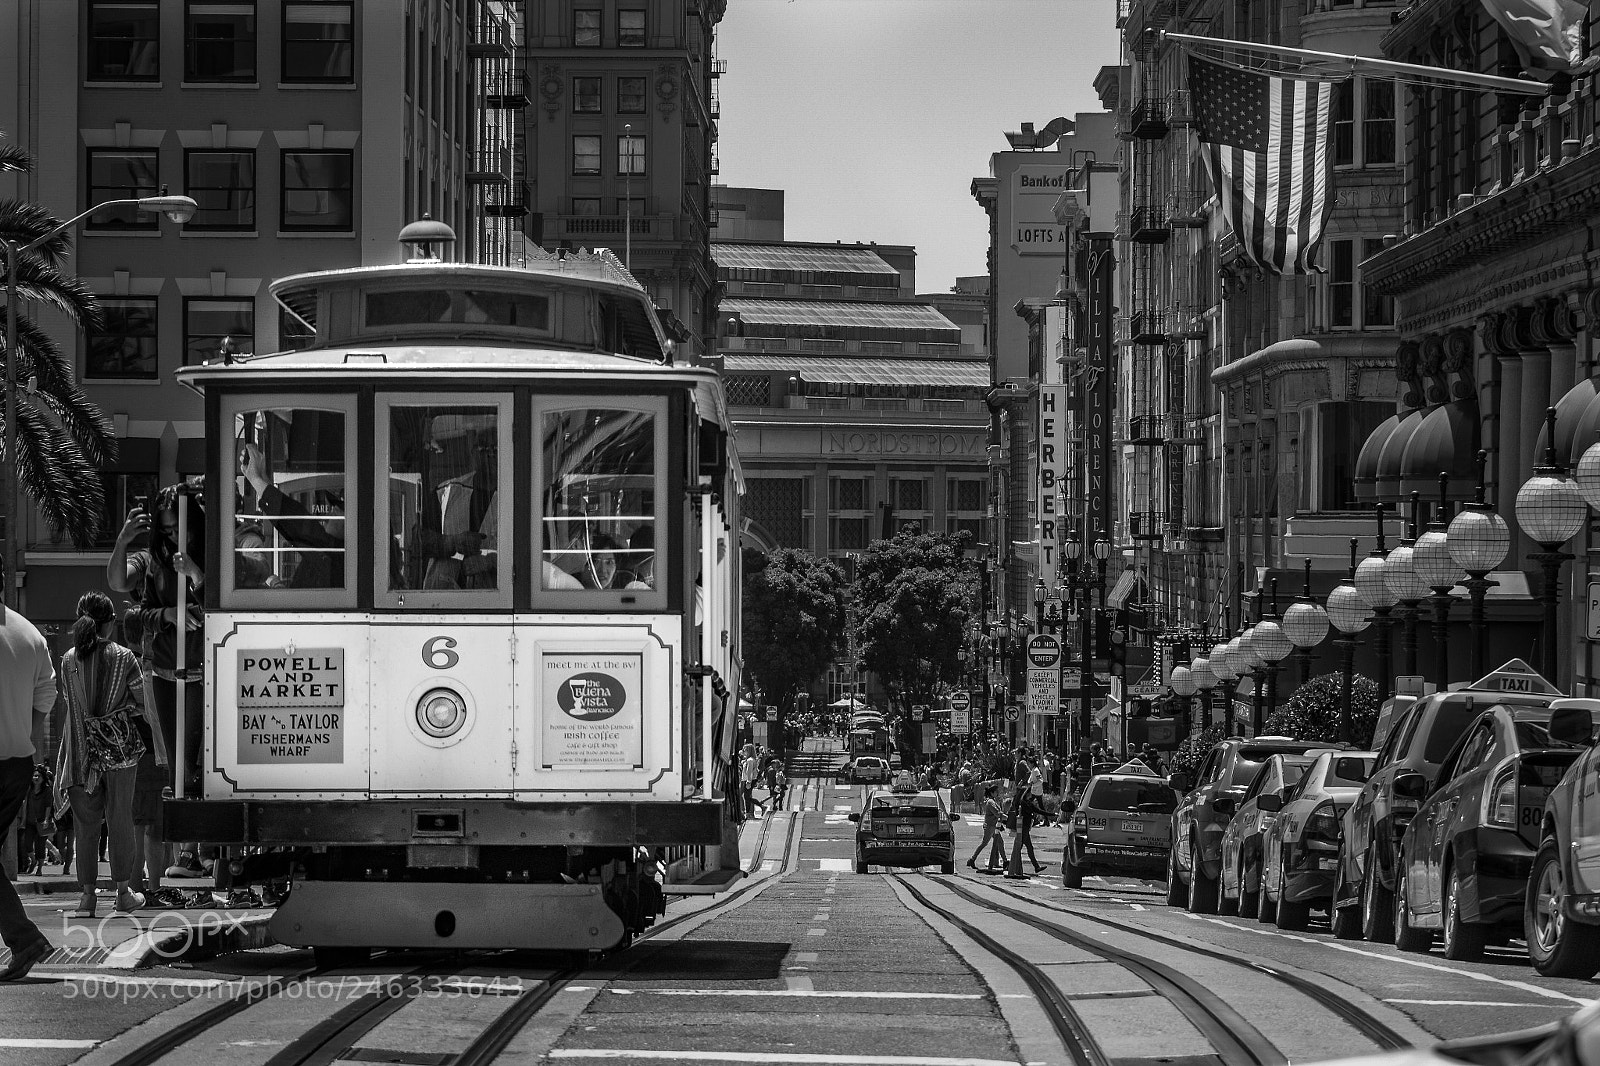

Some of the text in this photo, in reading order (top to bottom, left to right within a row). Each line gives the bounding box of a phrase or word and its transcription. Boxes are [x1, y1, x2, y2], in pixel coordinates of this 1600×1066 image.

[1021, 175, 1050, 187] Bank
[1018, 229, 1053, 242] LOFTS
[1087, 249, 1110, 361] VILLA
[829, 432, 980, 455] NORDSTROM
[1043, 392, 1056, 565] HERBERT
[422, 635, 459, 669] 6
[243, 657, 338, 671] POWELL
[268, 673, 314, 683] AND
[1501, 678, 1530, 691] TAXI
[241, 684, 339, 698] MARKET
[1134, 686, 1160, 694] GEARY
[242, 714, 266, 730] BAY
[290, 714, 339, 730] TAYLOR
[251, 733, 331, 745] FISHERMANS
[270, 746, 311, 757] WHARF
[1088, 817, 1107, 826] 1348
